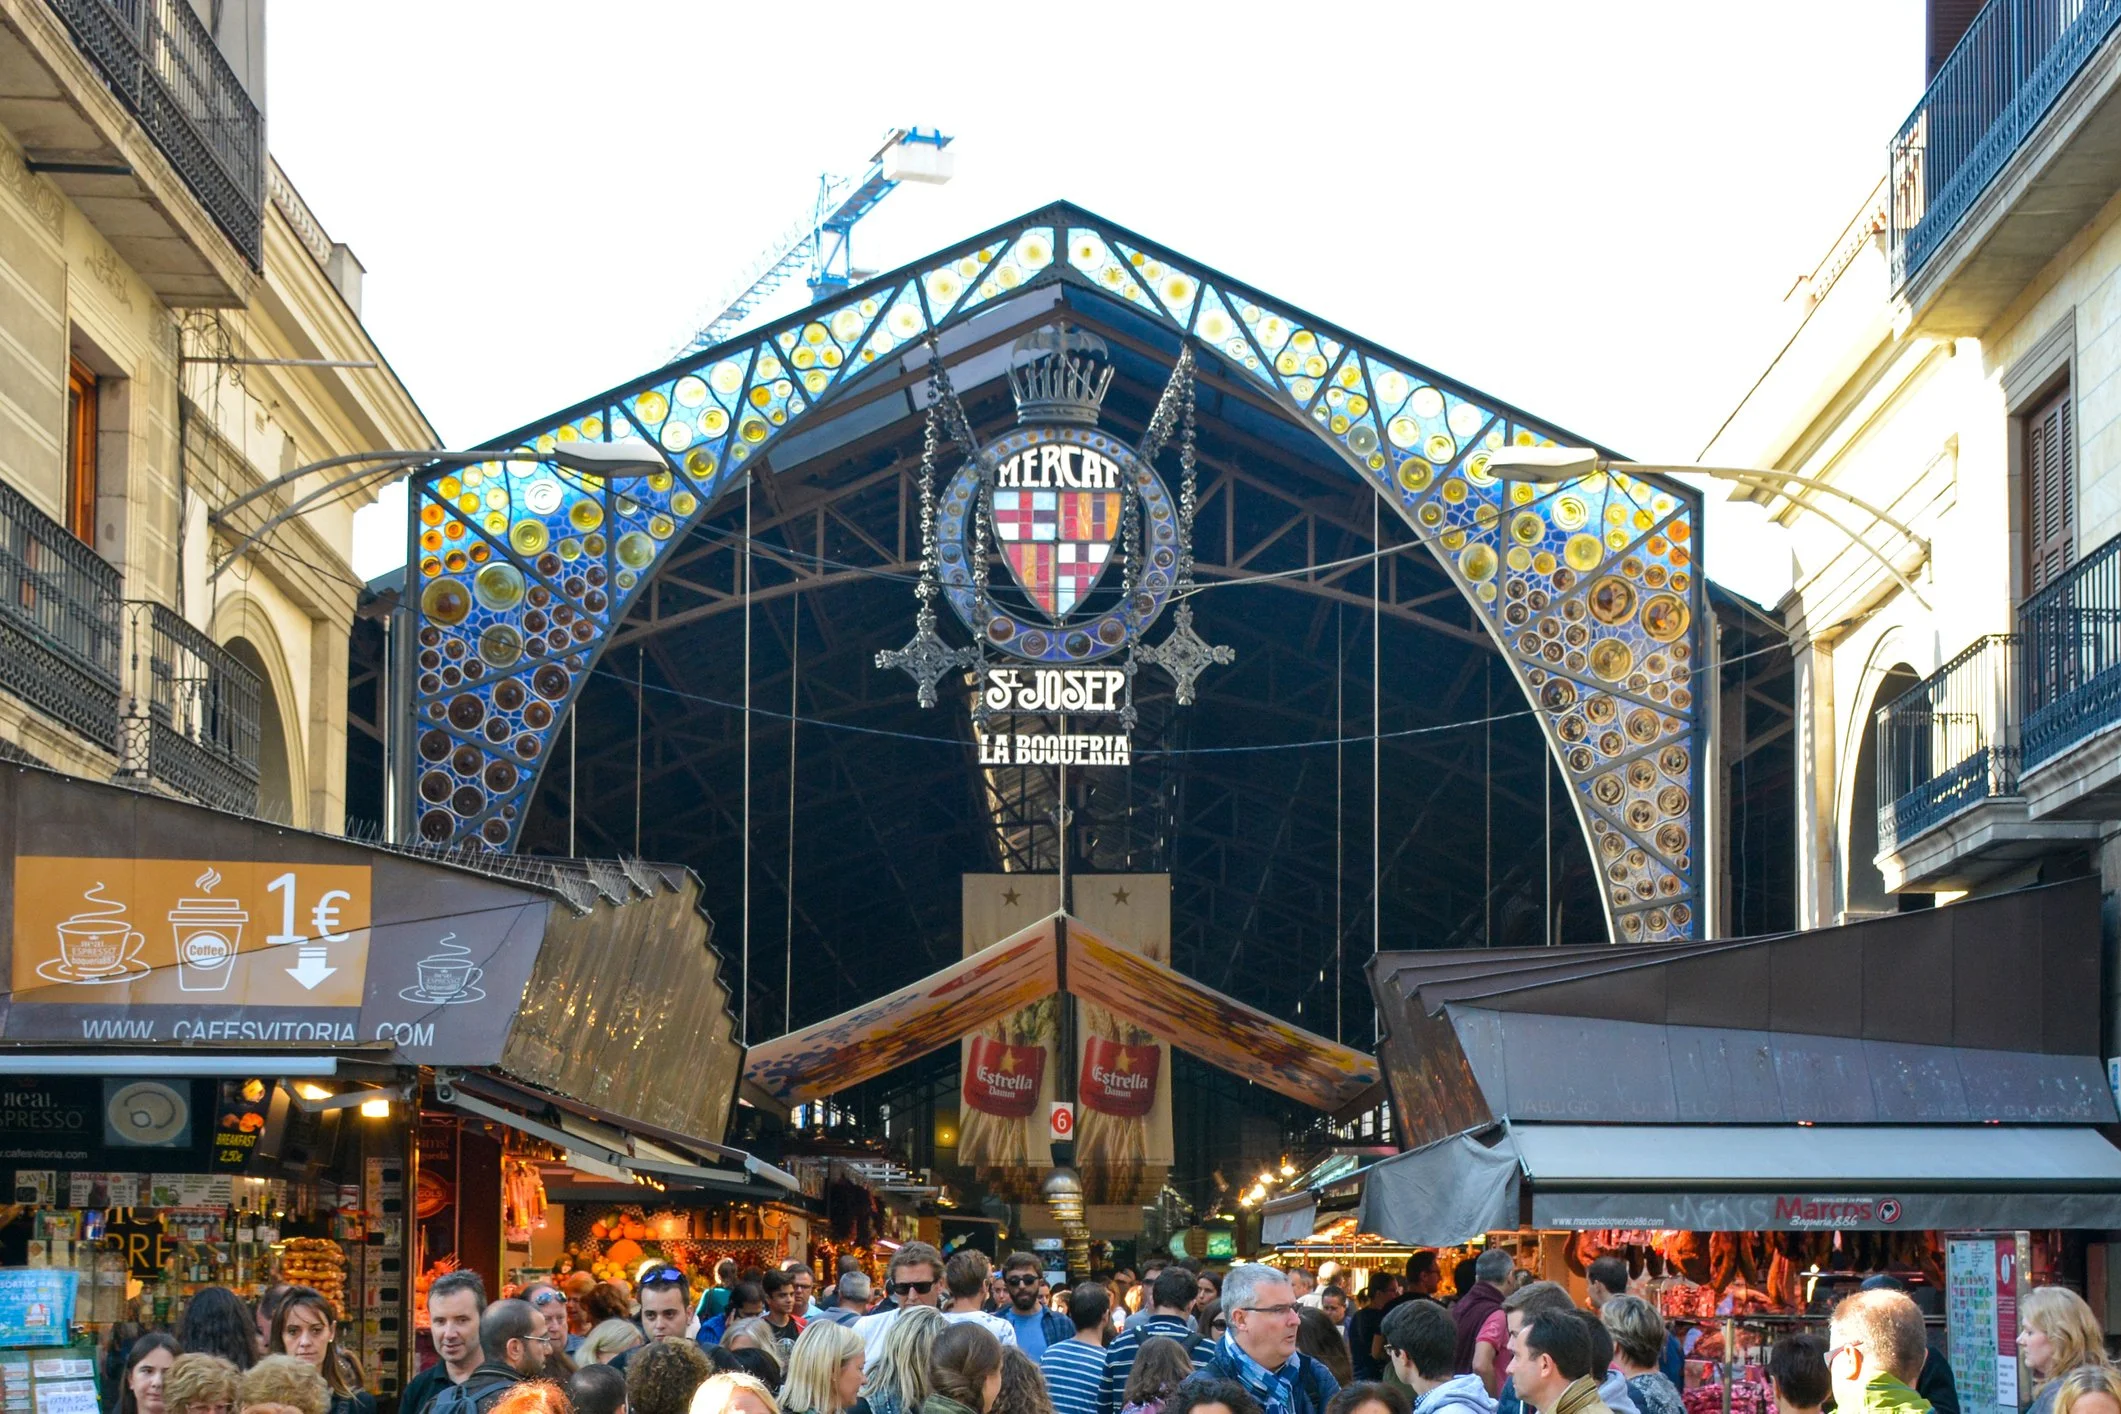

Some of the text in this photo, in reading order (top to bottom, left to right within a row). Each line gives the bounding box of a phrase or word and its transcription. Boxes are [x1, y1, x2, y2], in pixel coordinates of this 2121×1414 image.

[998, 444, 1120, 488] MERCAT
[1017, 669, 1125, 710] JOSEP
[980, 734, 1130, 765] LA BOQUERIA
[189, 945, 225, 957] Coffee
[976, 1065, 1033, 1090] Estrella
[1091, 1064, 1149, 1090] Estrella
[988, 1086, 1016, 1099] Damm
[1104, 1085, 1132, 1098] Damm
[1057, 1112, 1068, 1130] 6
[216, 1133, 257, 1147] BREAKFAST
[1775, 1196, 1873, 1221] Marcos
[1832, 1214, 1859, 1227] 886
